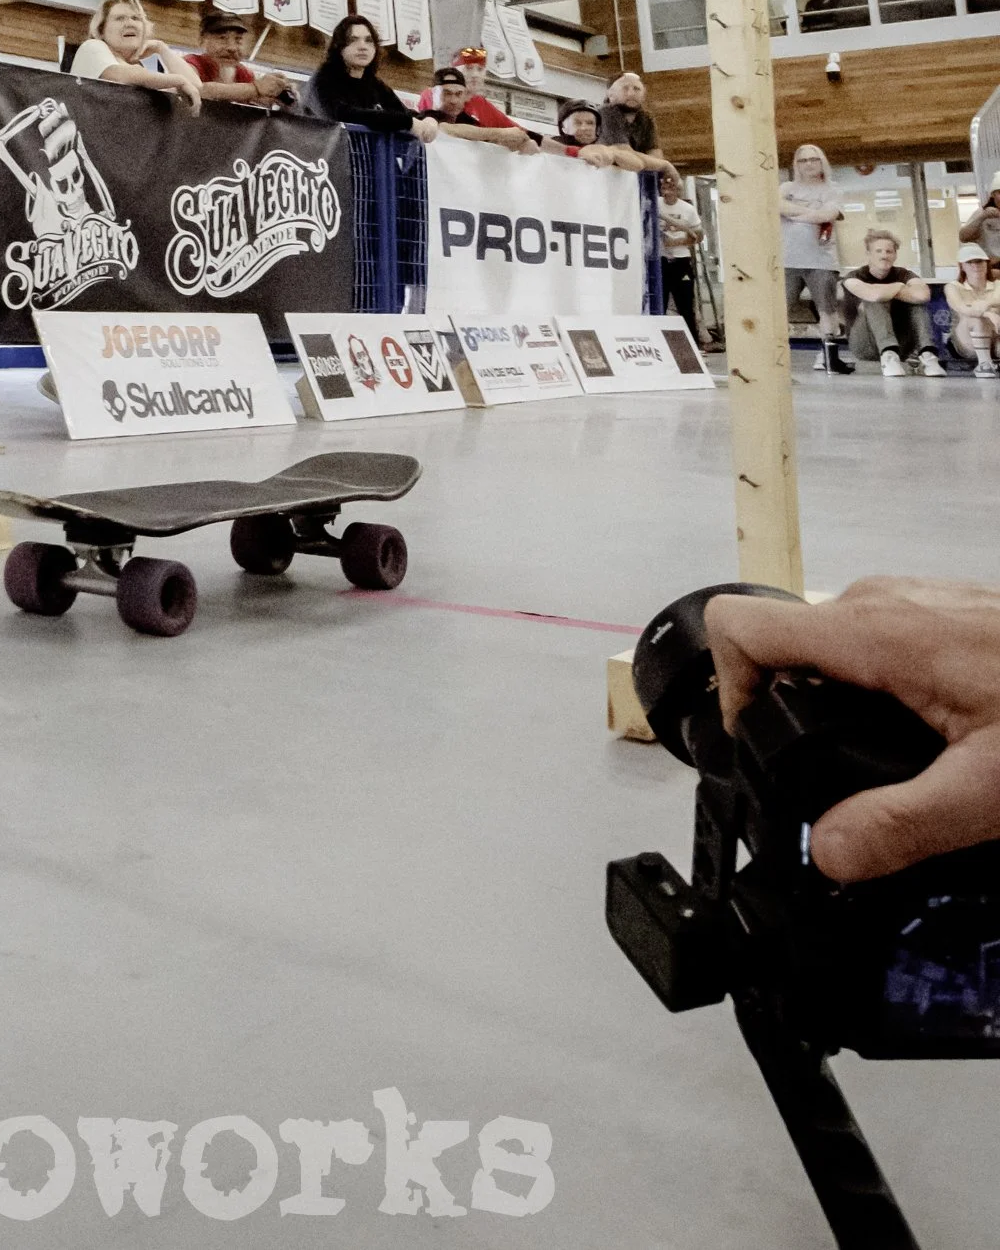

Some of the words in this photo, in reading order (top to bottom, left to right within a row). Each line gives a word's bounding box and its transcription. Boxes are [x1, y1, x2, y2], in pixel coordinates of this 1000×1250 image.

[101, 325, 221, 359] JOECORP
[616, 344, 663, 362] TASHME
[127, 380, 254, 419] Skullcandy
